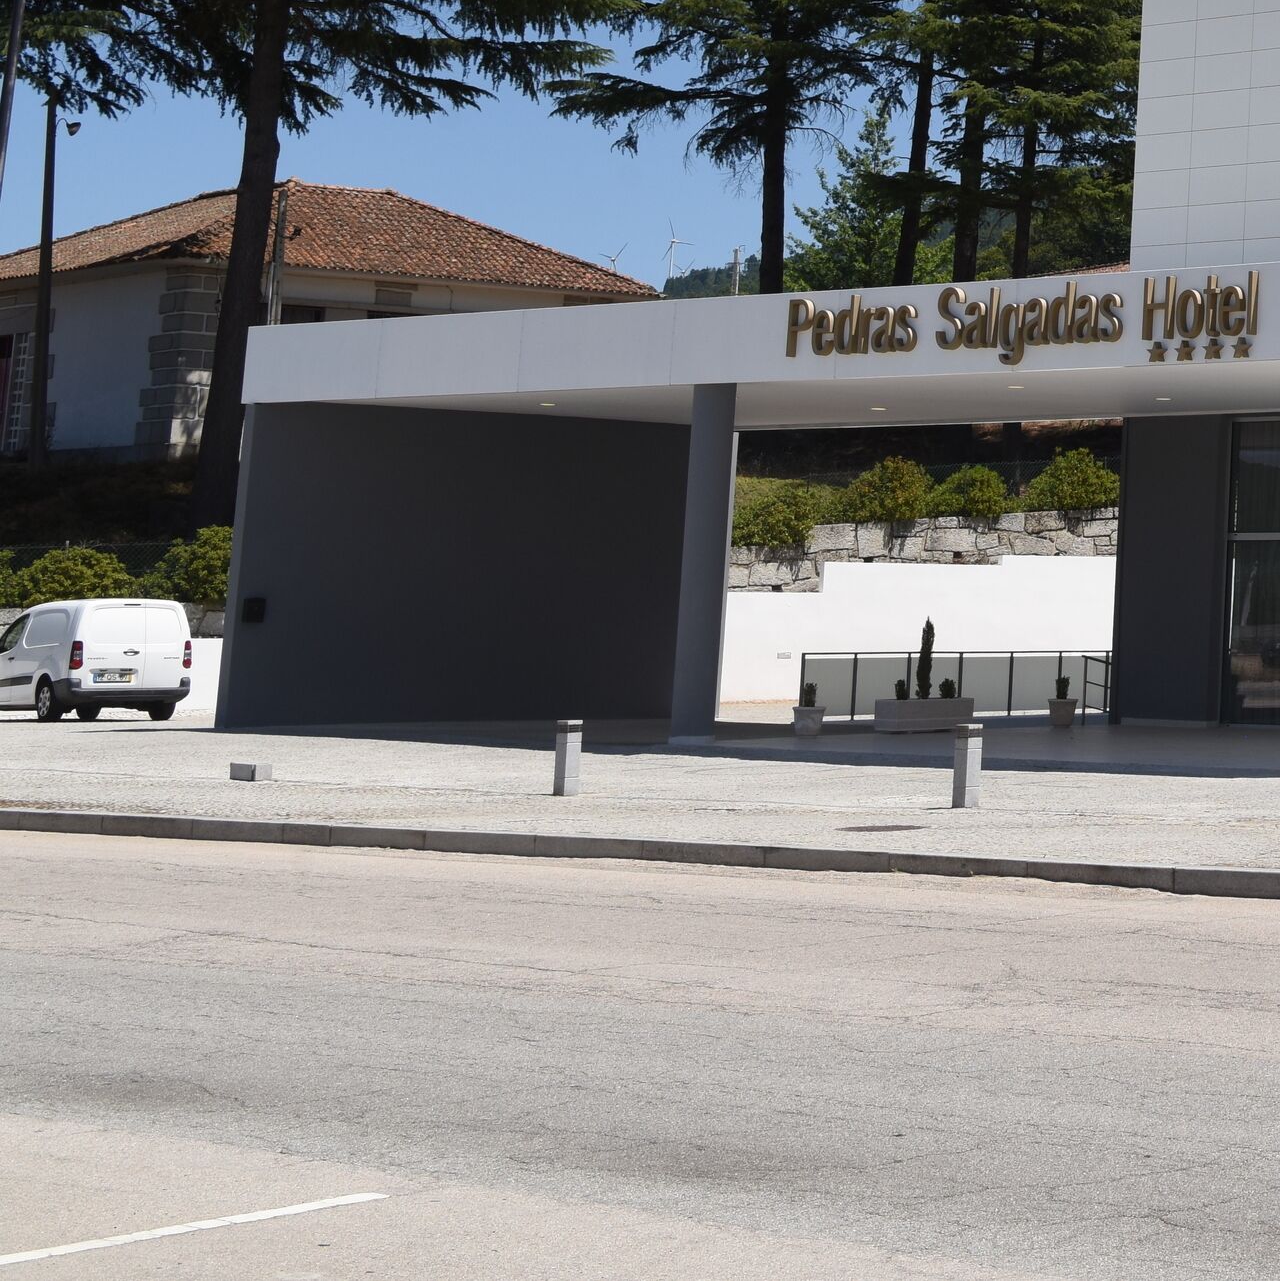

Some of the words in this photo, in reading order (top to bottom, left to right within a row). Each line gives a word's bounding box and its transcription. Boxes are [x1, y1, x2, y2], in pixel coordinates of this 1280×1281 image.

[785, 293, 918, 357] Pedras
[935, 280, 1124, 365] Salgadas
[1141, 270, 1260, 341] Hotel
